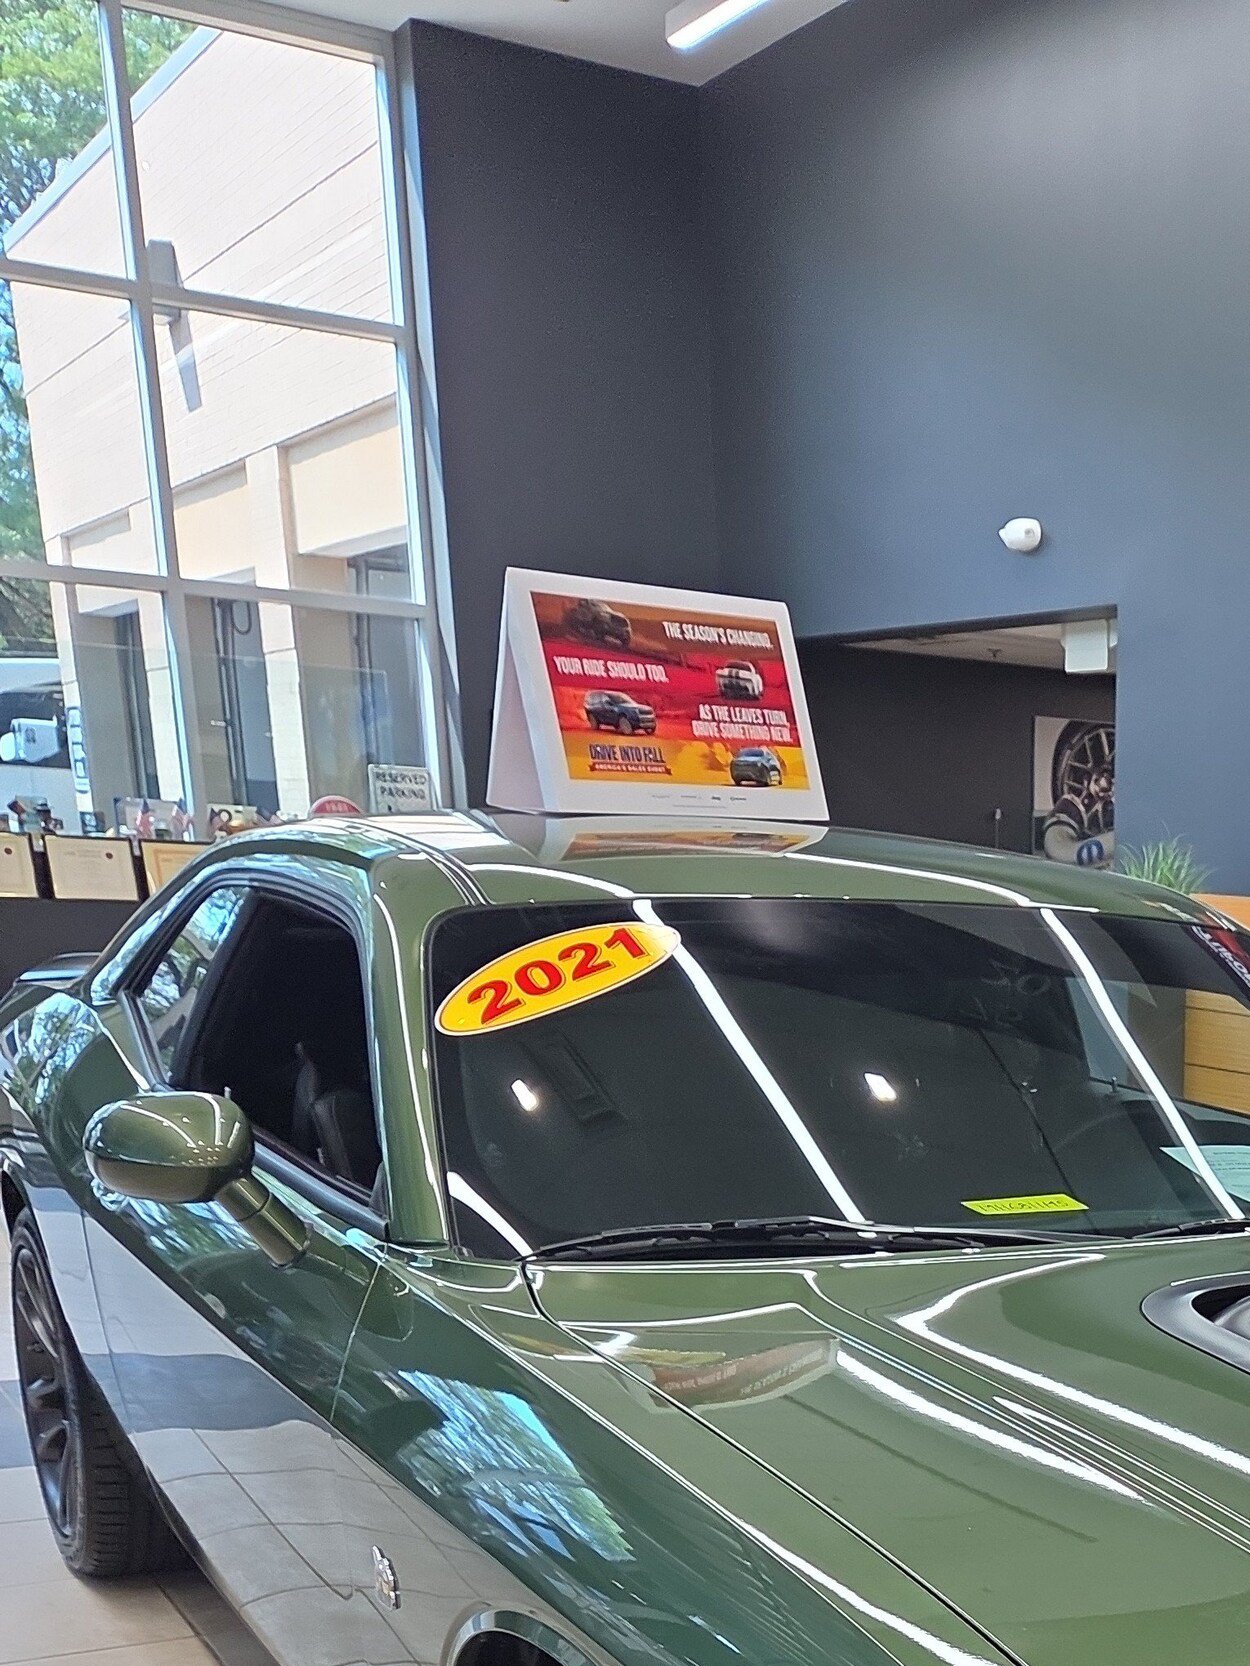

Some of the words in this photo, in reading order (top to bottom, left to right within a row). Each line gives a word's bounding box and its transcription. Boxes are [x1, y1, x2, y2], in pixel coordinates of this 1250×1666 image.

[662, 621, 683, 640] THE
[682, 623, 727, 645] SEASON'S
[553, 655, 583, 676] YOUR
[582, 658, 607, 678] RIDE
[606, 660, 647, 682] SHOULD
[645, 664, 670, 683] TOO.
[699, 703, 713, 721] AS
[711, 705, 731, 722] THE
[730, 706, 764, 724] LEAVES
[691, 720, 720, 739] DRIVE
[719, 723, 771, 741] SOMETHING
[589, 744, 619, 761] DRIVE
[619, 745, 643, 763] INTO
[642, 746, 667, 764] FALL
[375, 770, 427, 786] RESERVED
[380, 785, 426, 800] PARKING
[467, 927, 650, 1026] 2021
